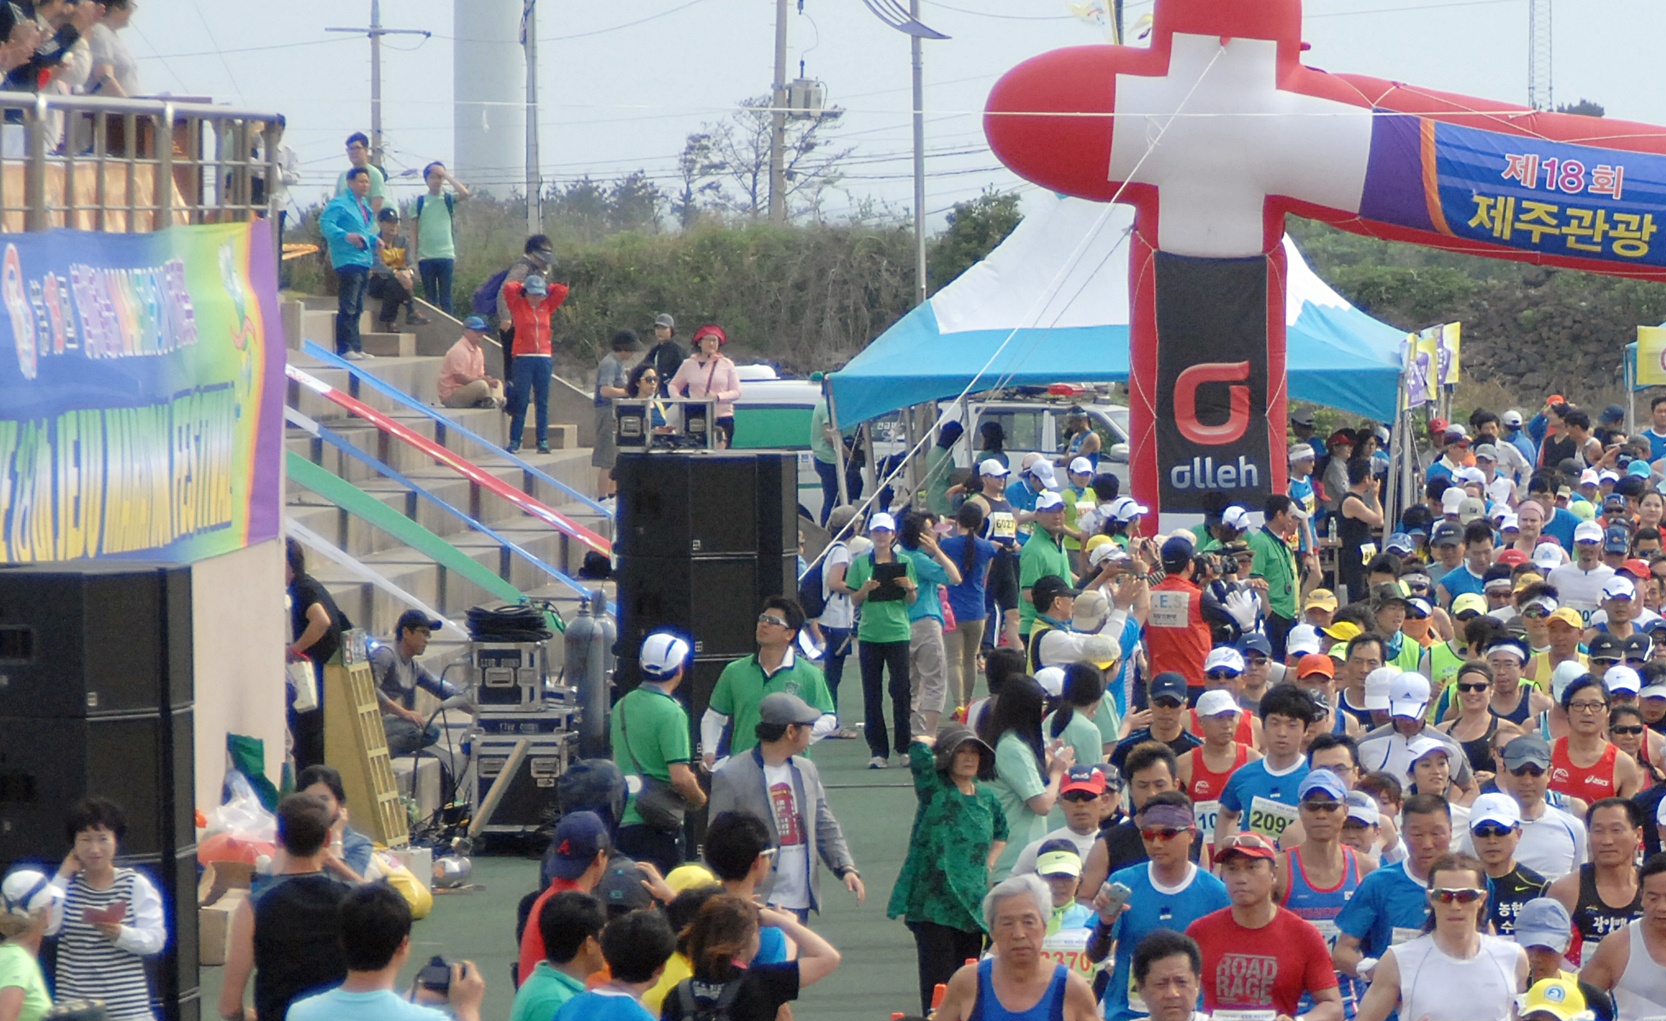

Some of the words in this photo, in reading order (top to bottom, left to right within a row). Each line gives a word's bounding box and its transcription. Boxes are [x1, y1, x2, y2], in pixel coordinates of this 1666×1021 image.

[1502, 152, 1625, 200] 제18회
[1467, 193, 1657, 258] 제주관광
[1170, 455, 1259, 489] olleh
[1216, 957, 1278, 982] ROAD
[1216, 979, 1276, 999] RAGE
